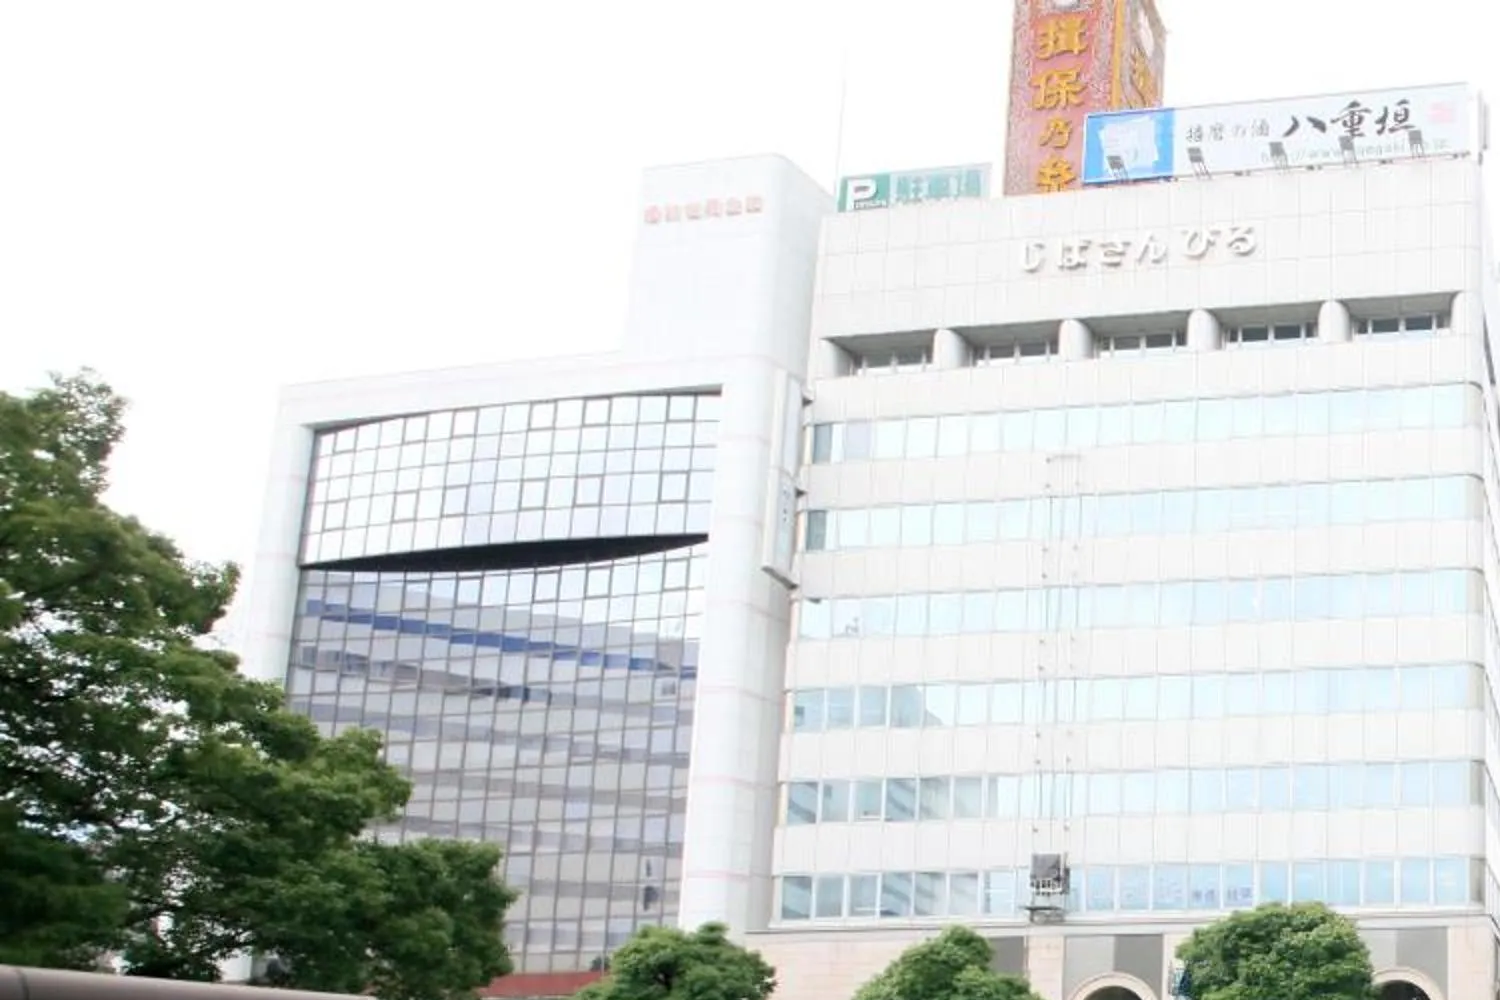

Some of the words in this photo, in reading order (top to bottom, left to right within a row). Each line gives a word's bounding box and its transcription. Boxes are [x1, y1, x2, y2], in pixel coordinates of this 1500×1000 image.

[1282, 98, 1419, 139] 八重垣
[847, 178, 877, 211] P
